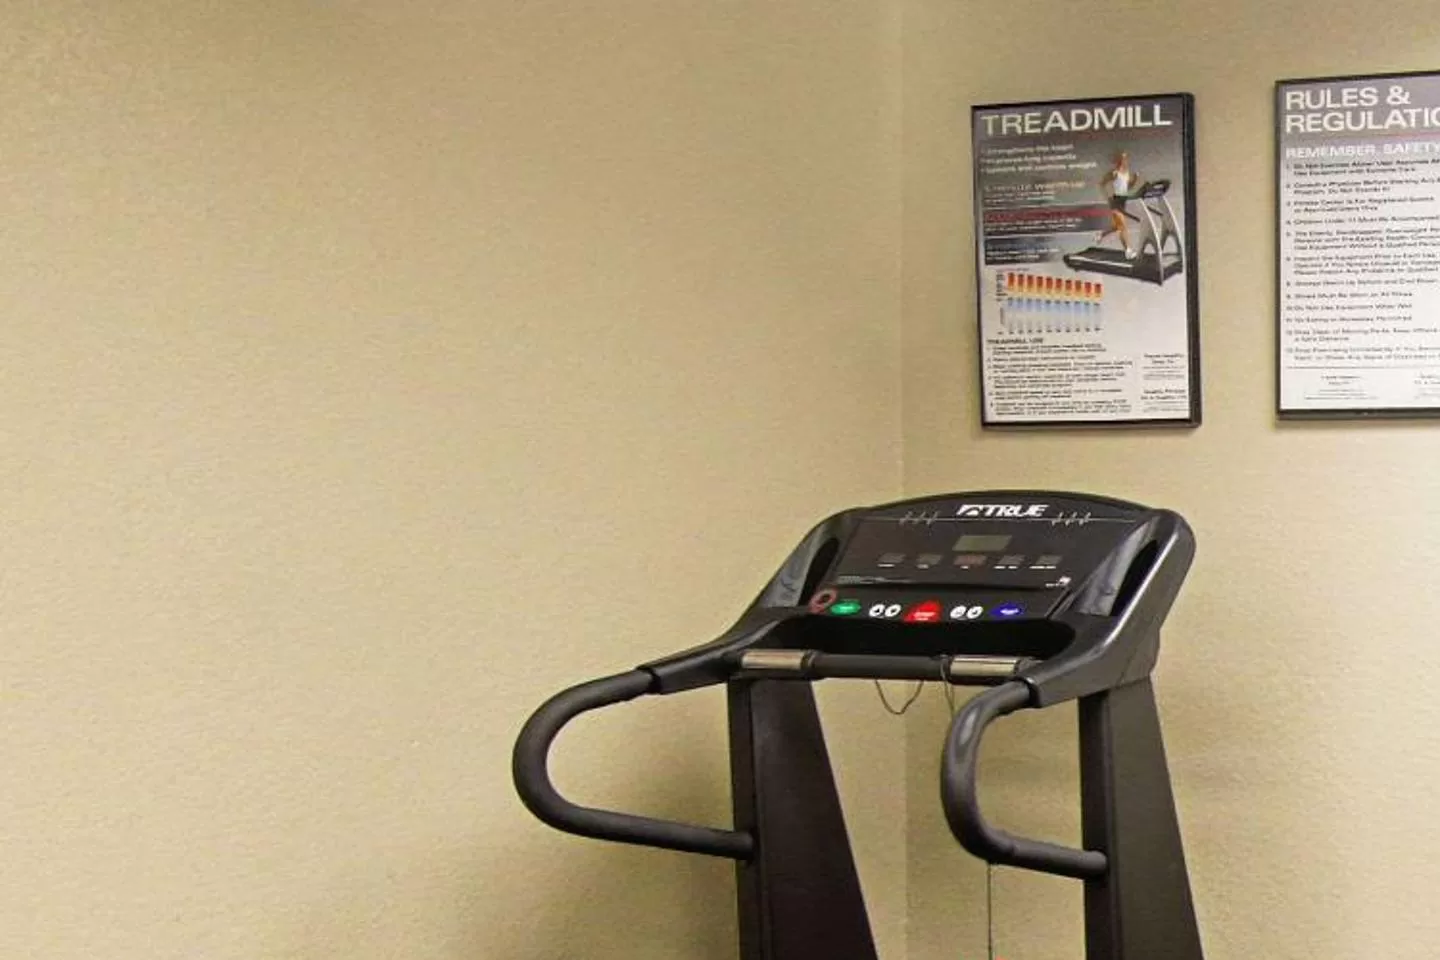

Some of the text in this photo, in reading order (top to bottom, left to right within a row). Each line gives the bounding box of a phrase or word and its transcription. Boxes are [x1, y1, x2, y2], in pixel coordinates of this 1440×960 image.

[1286, 85, 1411, 110] RULES &
[980, 104, 1173, 136] TREADMILL
[983, 504, 1050, 517] TRUE
